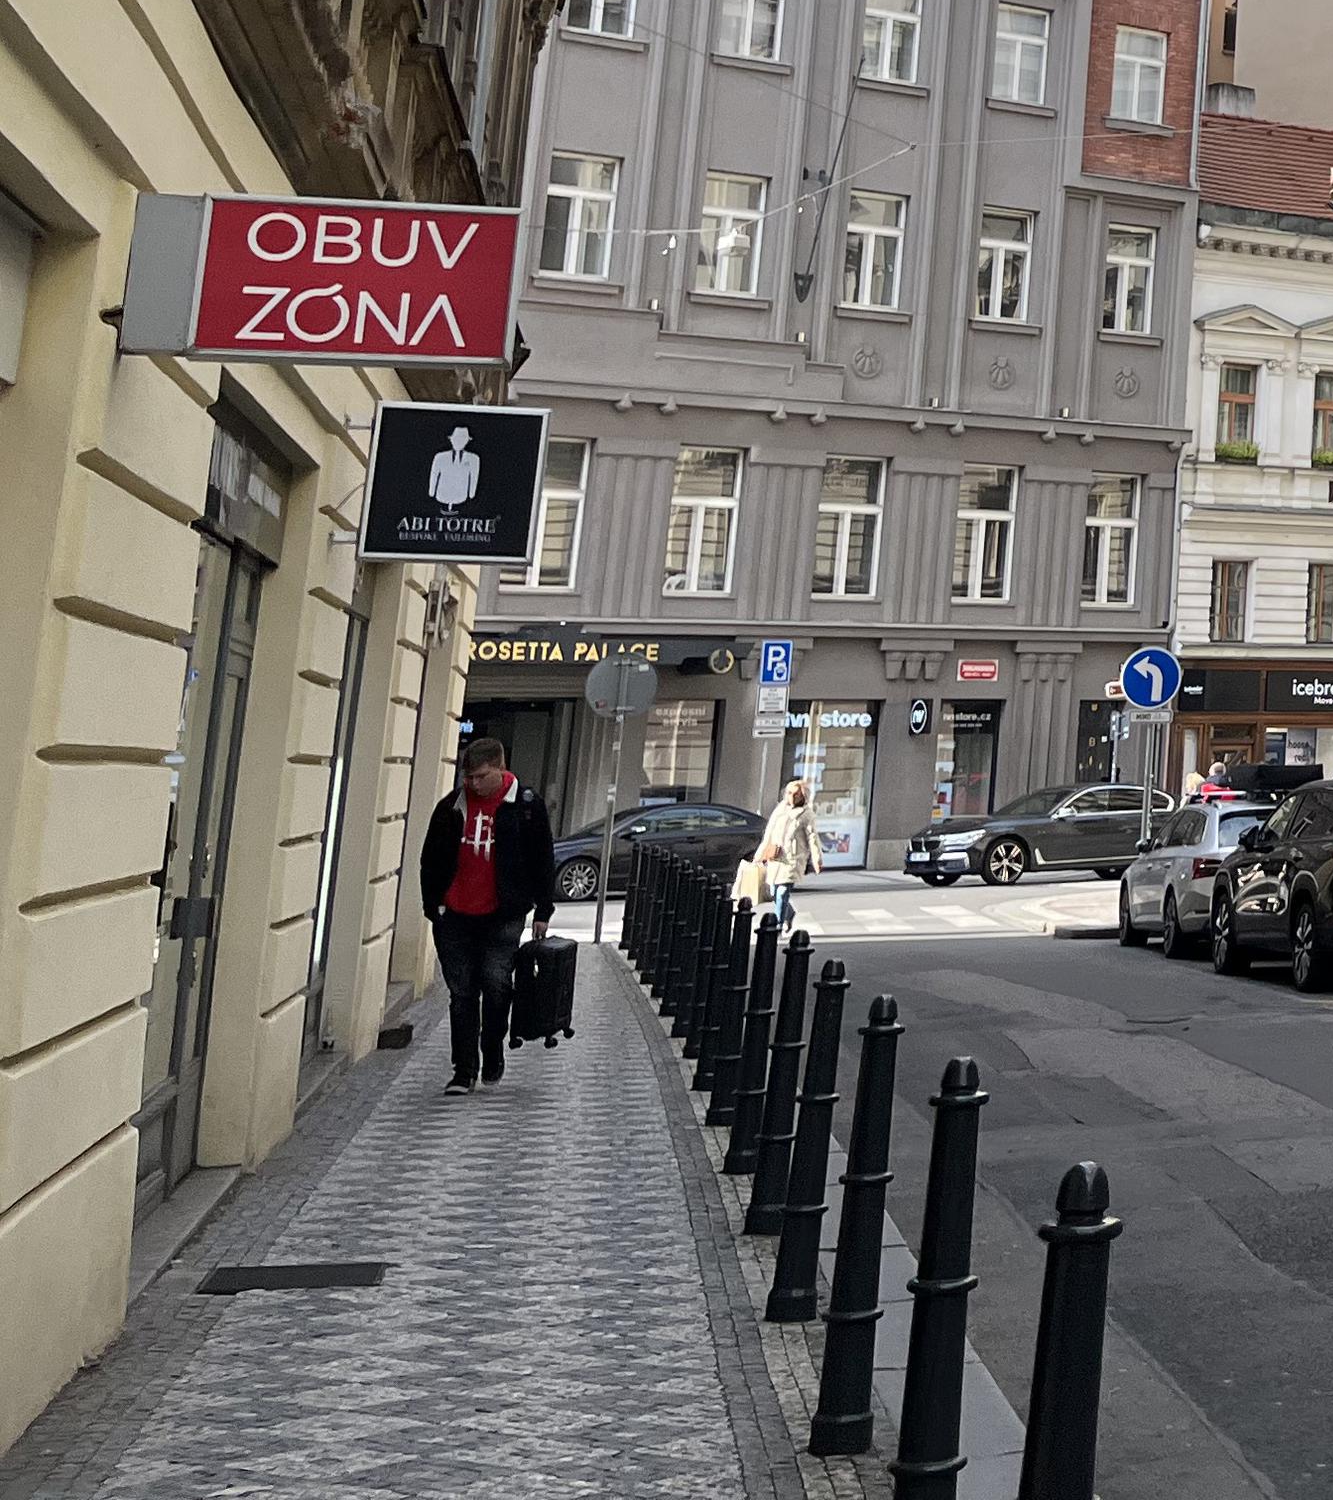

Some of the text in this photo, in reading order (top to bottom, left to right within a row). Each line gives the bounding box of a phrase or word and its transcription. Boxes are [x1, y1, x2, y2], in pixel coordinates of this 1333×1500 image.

[247, 212, 480, 269] OBUV
[235, 283, 466, 347] ZÓNA
[396, 516, 430, 531] ABI
[470, 640, 564, 662] ROSETTA
